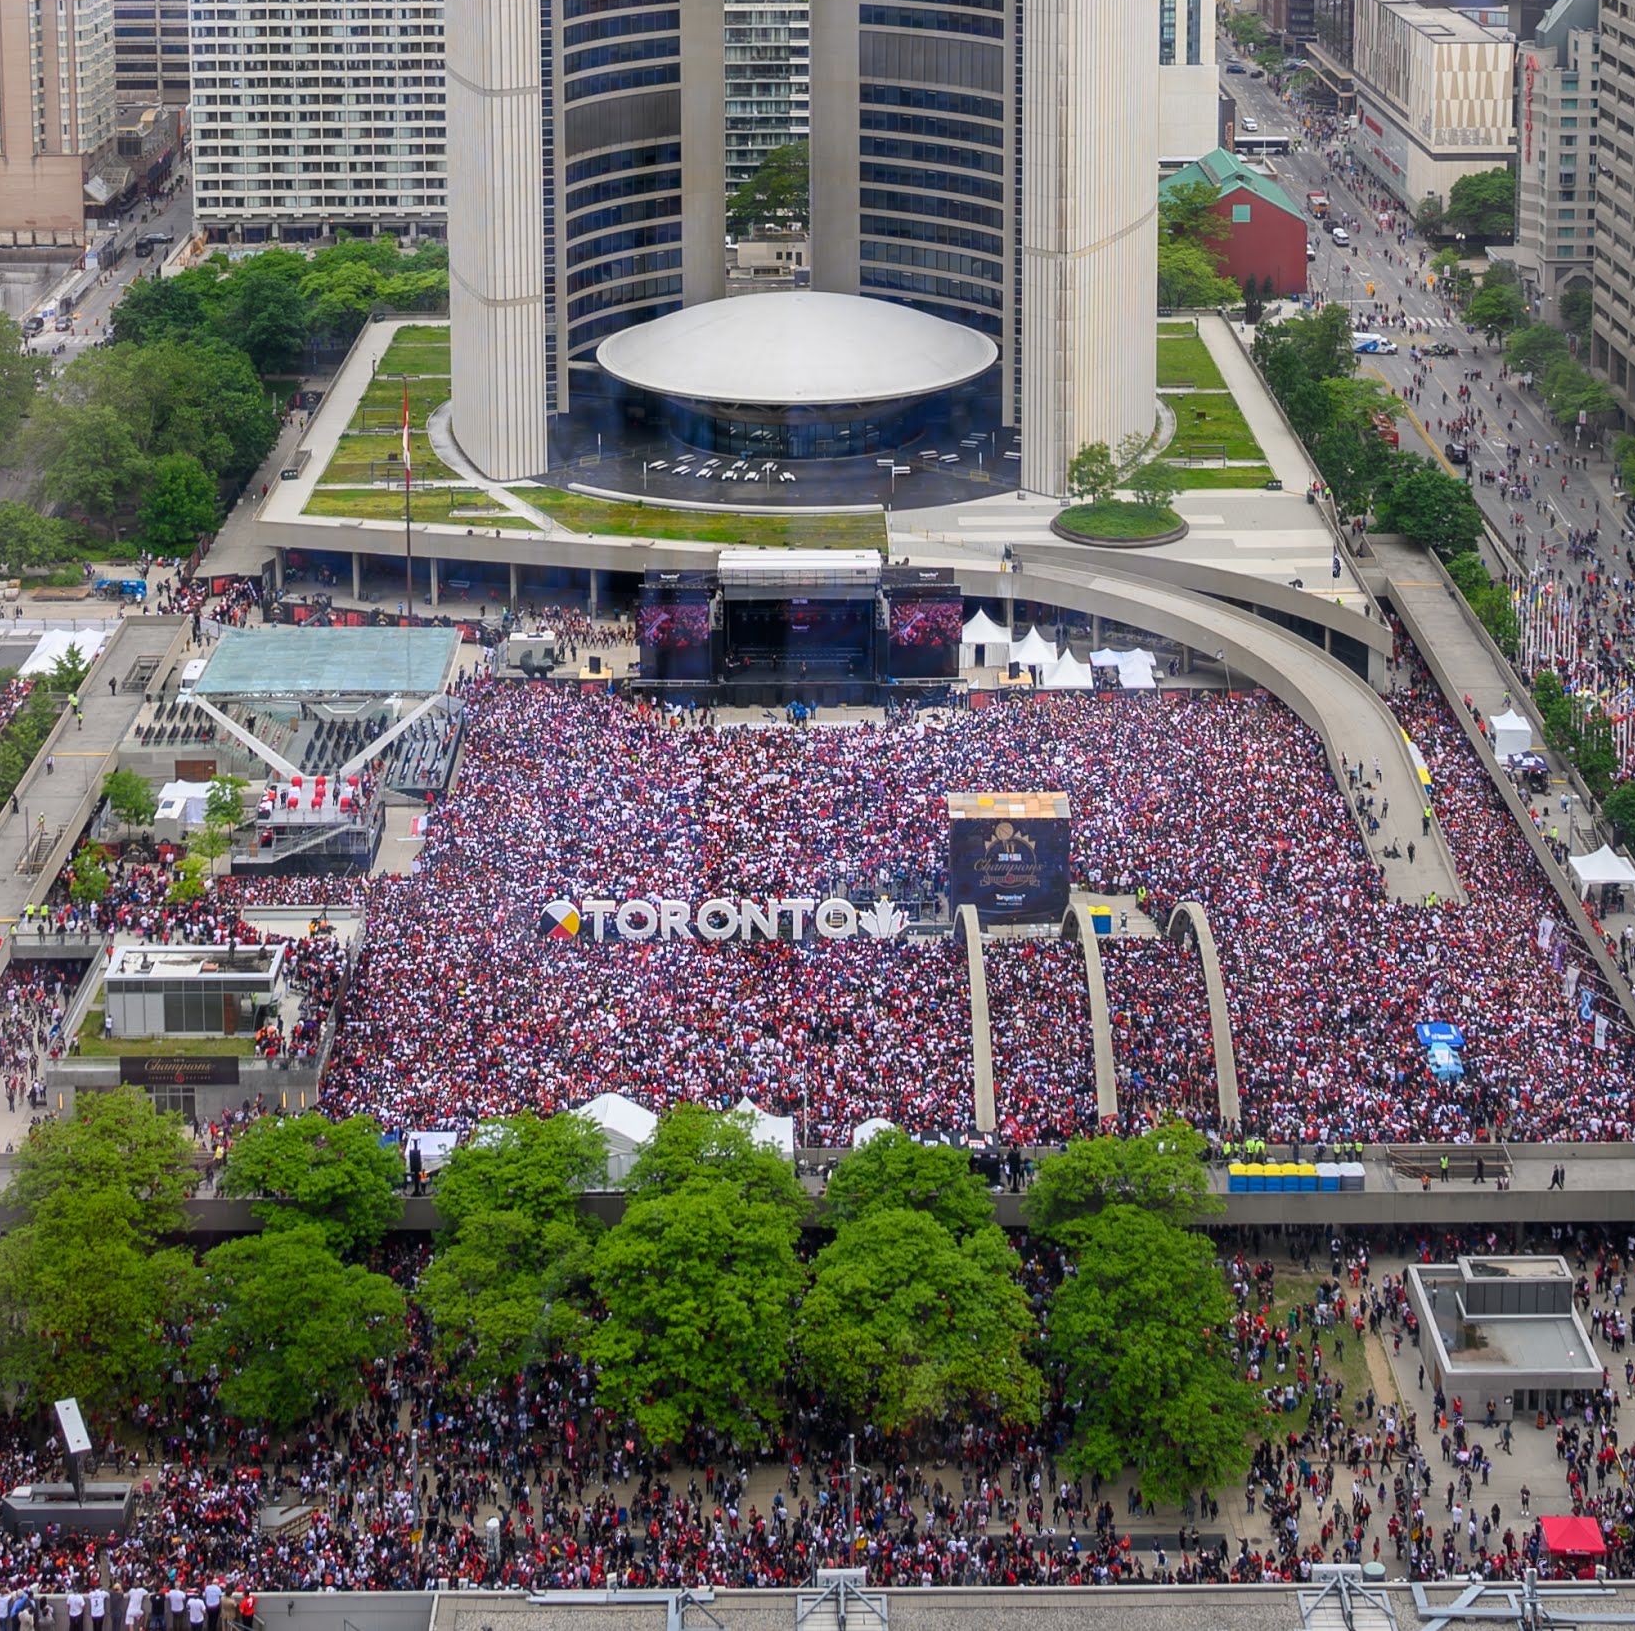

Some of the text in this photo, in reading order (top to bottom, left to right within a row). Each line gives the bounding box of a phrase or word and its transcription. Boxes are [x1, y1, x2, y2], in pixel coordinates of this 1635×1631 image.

[974, 857, 1044, 876] Champions
[582, 897, 857, 941] TORONTO
[145, 1058, 213, 1074] Champions
